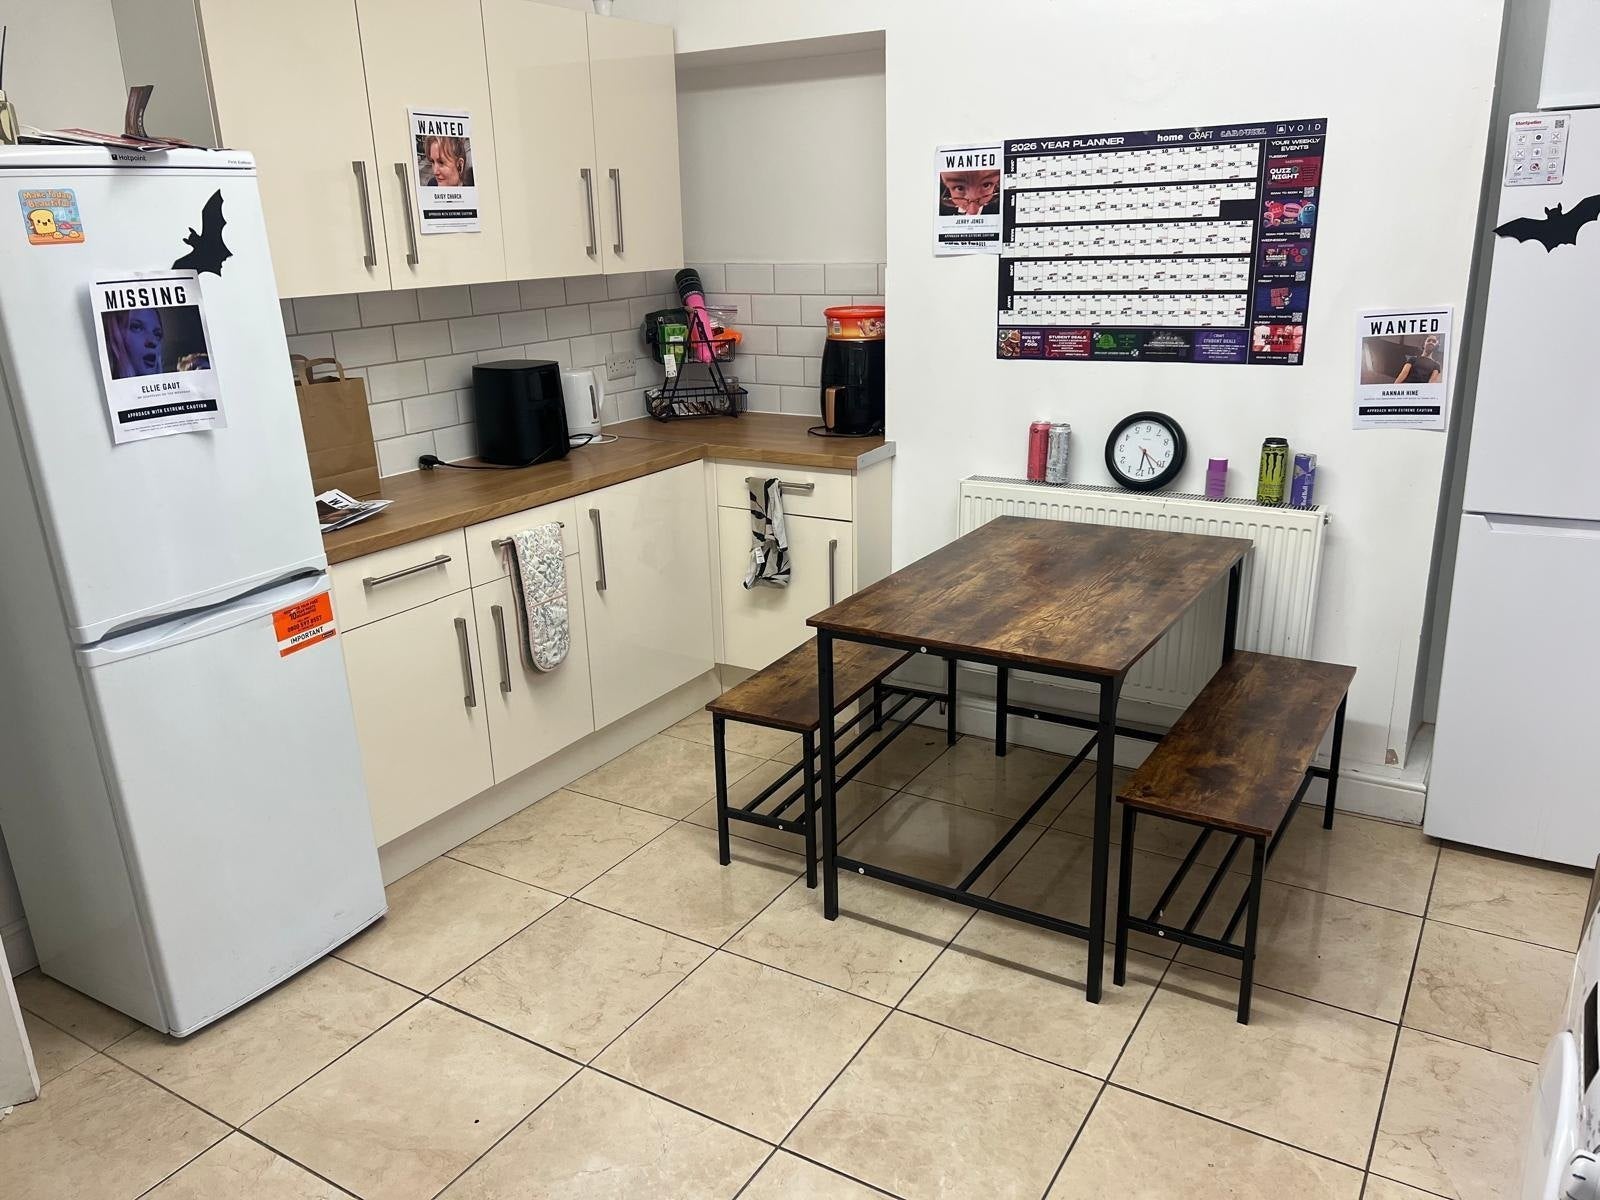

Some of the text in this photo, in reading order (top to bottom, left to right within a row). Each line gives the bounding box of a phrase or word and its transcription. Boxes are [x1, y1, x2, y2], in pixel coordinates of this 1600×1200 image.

[418, 120, 464, 136] WANTED
[1157, 124, 1320, 142] home CRAFT CAROUSEL VOID
[1010, 138, 1124, 152] 2026 YEAR PLANNER
[946, 154, 996, 168] WANTED
[23, 190, 72, 201] Make Today
[27, 198, 70, 208] Beautiful
[104, 286, 187, 310] MISSING
[1370, 318, 1439, 335] WANTED
[142, 382, 180, 394] ELLIE GAUT
[127, 410, 150, 418] APPROACH
[1146, 425, 1152, 433] 6
[1156, 429, 1162, 437] 7
[1126, 434, 1130, 442] 4
[1164, 438, 1169, 446] 8
[1120, 444, 1124, 452] 3
[1165, 450, 1170, 458] 9
[1120, 456, 1126, 464] 2
[1136, 469, 1144, 477] 12
[290, 626, 324, 644] IMPORTANT
